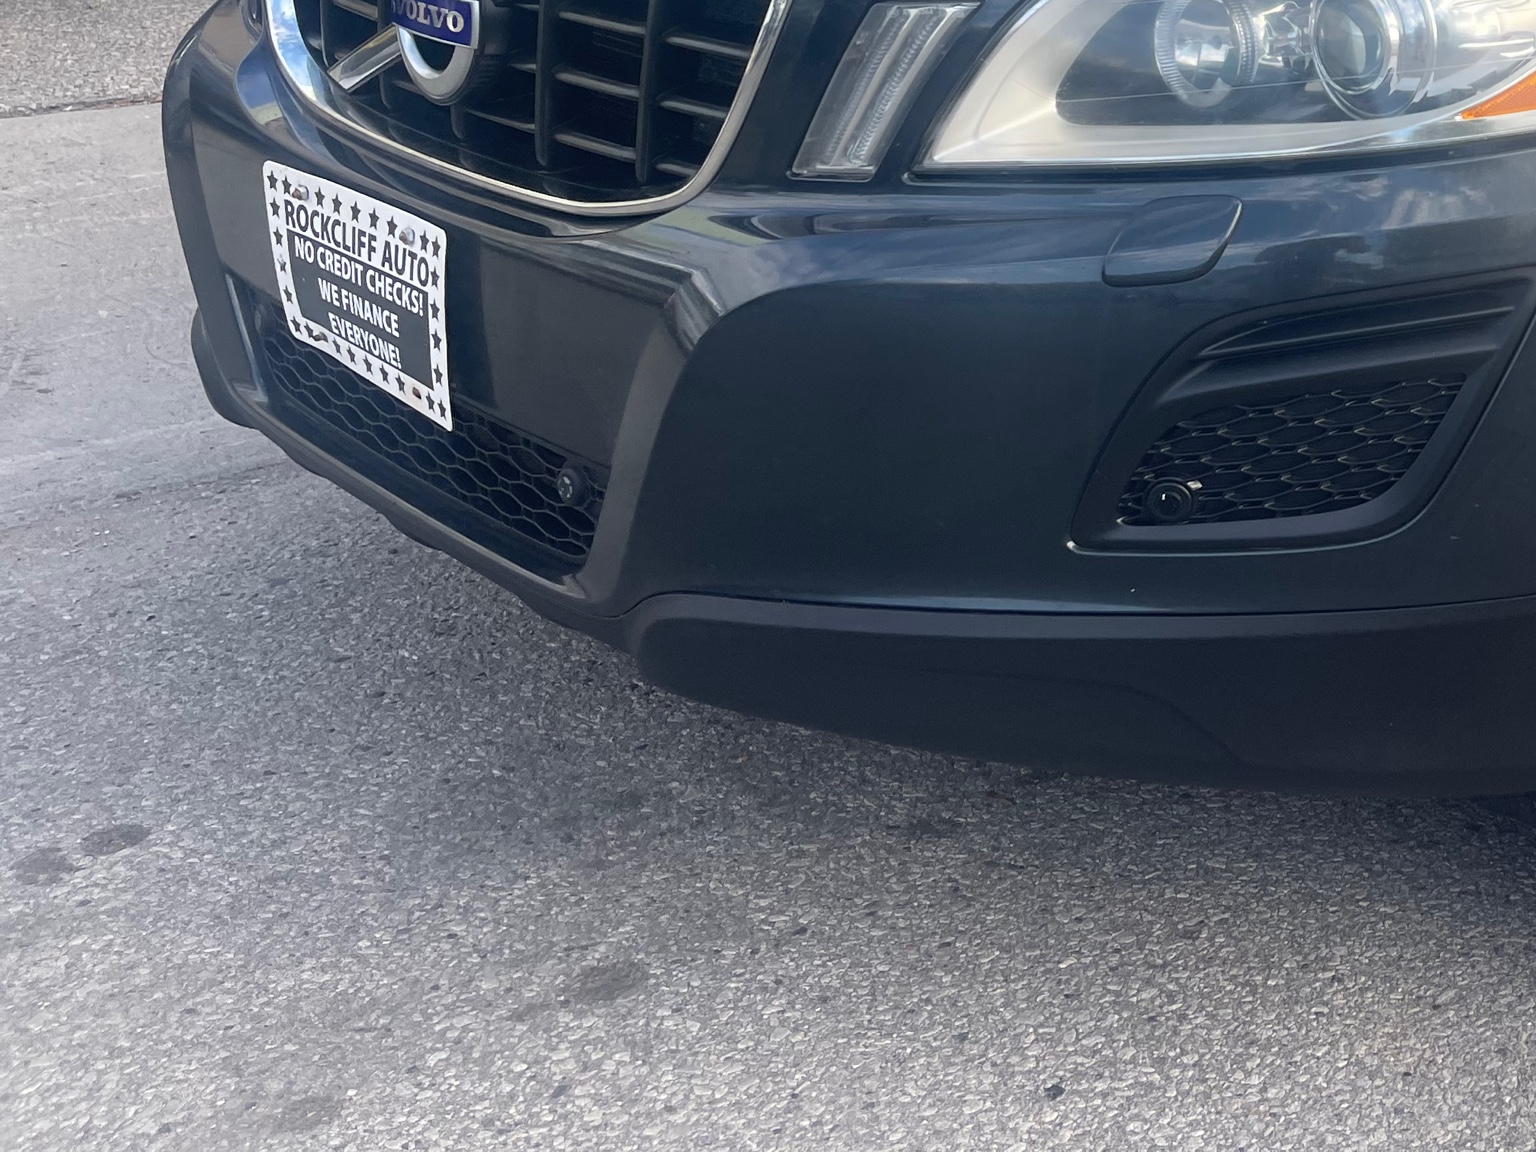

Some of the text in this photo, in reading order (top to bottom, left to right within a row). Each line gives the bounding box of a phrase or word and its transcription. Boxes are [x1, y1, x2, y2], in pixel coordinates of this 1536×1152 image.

[284, 199, 430, 288] ROCKCLIFF AUTO
[294, 237, 424, 317] NO CREDIT CHECKS!
[318, 277, 399, 338] WE FINANCE
[328, 312, 402, 370] EVERYONE!
